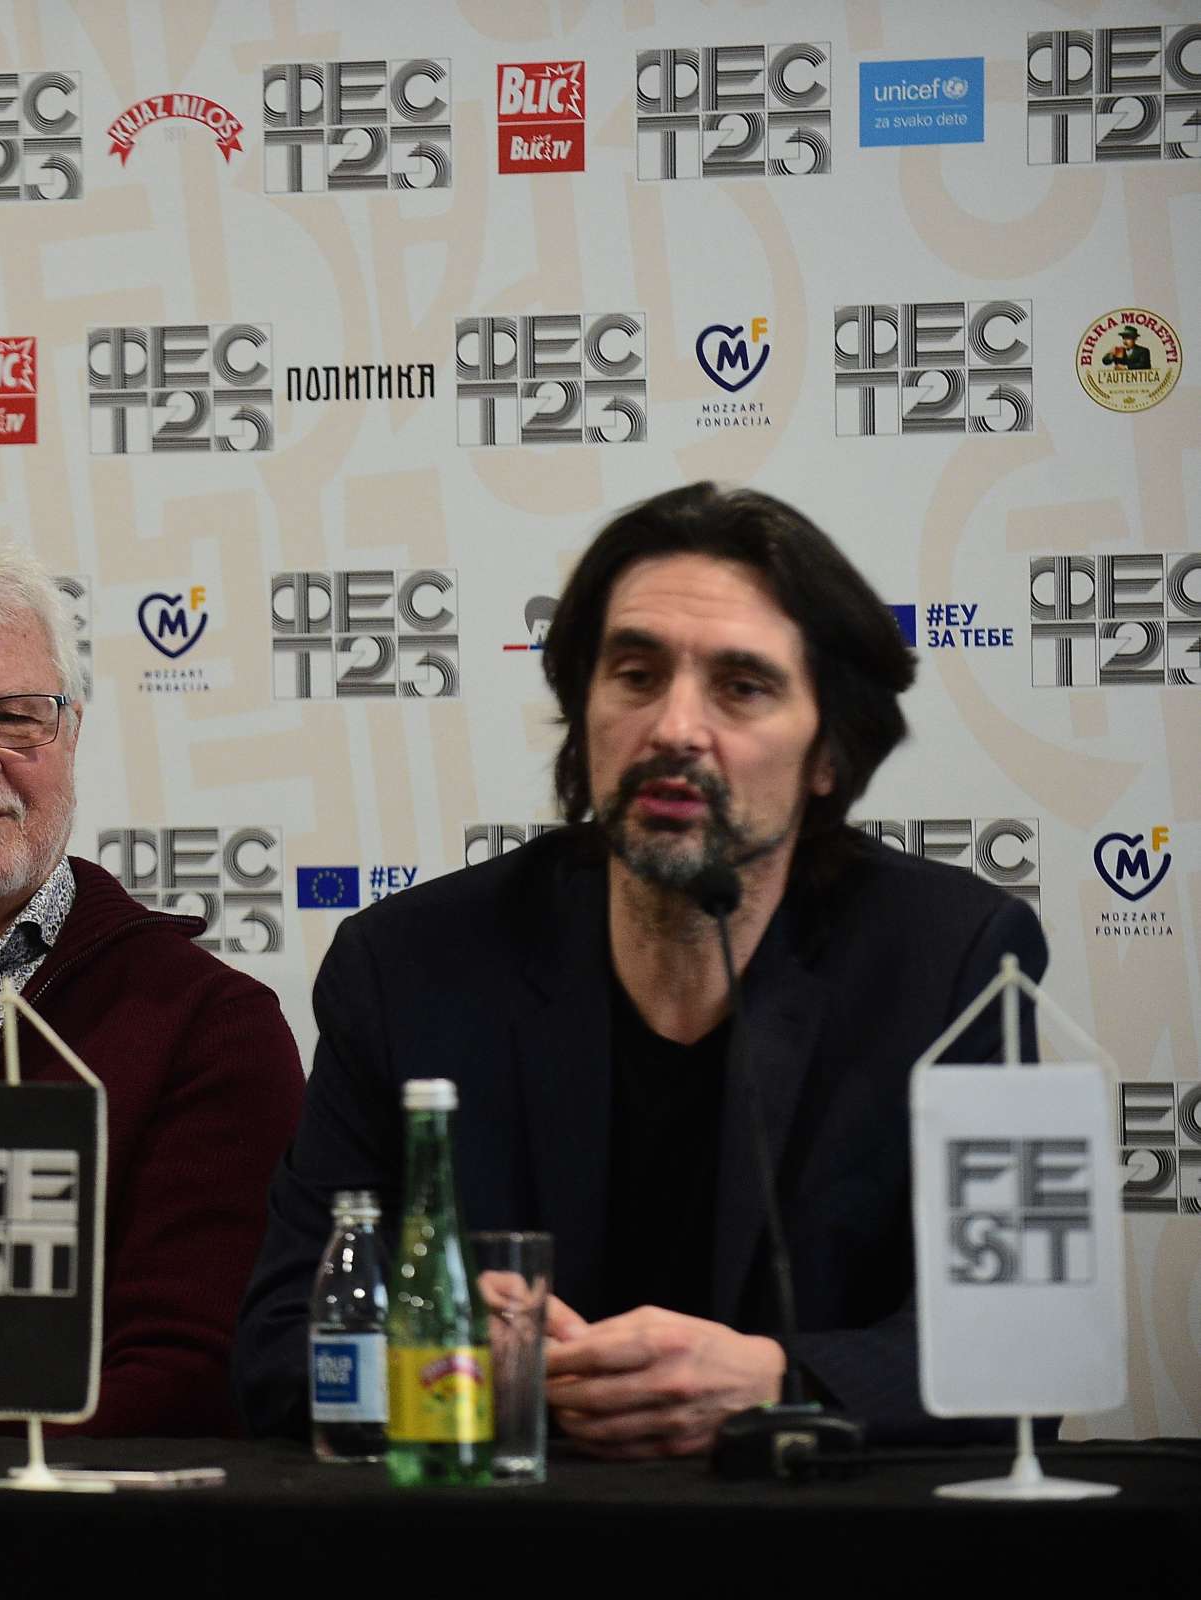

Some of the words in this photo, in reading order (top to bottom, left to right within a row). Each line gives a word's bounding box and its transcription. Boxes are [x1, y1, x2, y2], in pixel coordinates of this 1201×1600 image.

[263, 60, 451, 127] ФЕС
[499, 66, 568, 115] BLIC
[637, 43, 831, 113] ФЕС
[874, 78, 941, 102] unicef
[109, 97, 168, 143] KNJAZ
[875, 116, 890, 129] za
[893, 113, 933, 128] svako
[936, 112, 968, 127] dete
[88, 325, 273, 389] ФЕС
[456, 314, 647, 380] ФЕС
[834, 301, 1033, 369] ФЕС
[1080, 316, 1118, 366] BIRRA
[1121, 312, 1178, 364] MORETTI
[287, 364, 435, 402] ПОЛИТИКА
[696, 416, 771, 427] FONDACIJA
[702, 403, 764, 413] MOZZART
[271, 570, 459, 634] ФЕС
[927, 629, 956, 648] ЗА
[963, 628, 1014, 647] ТЕБЕ
[1095, 926, 1173, 937] FONDACIJA
[1101, 912, 1166, 923] MOZZART
